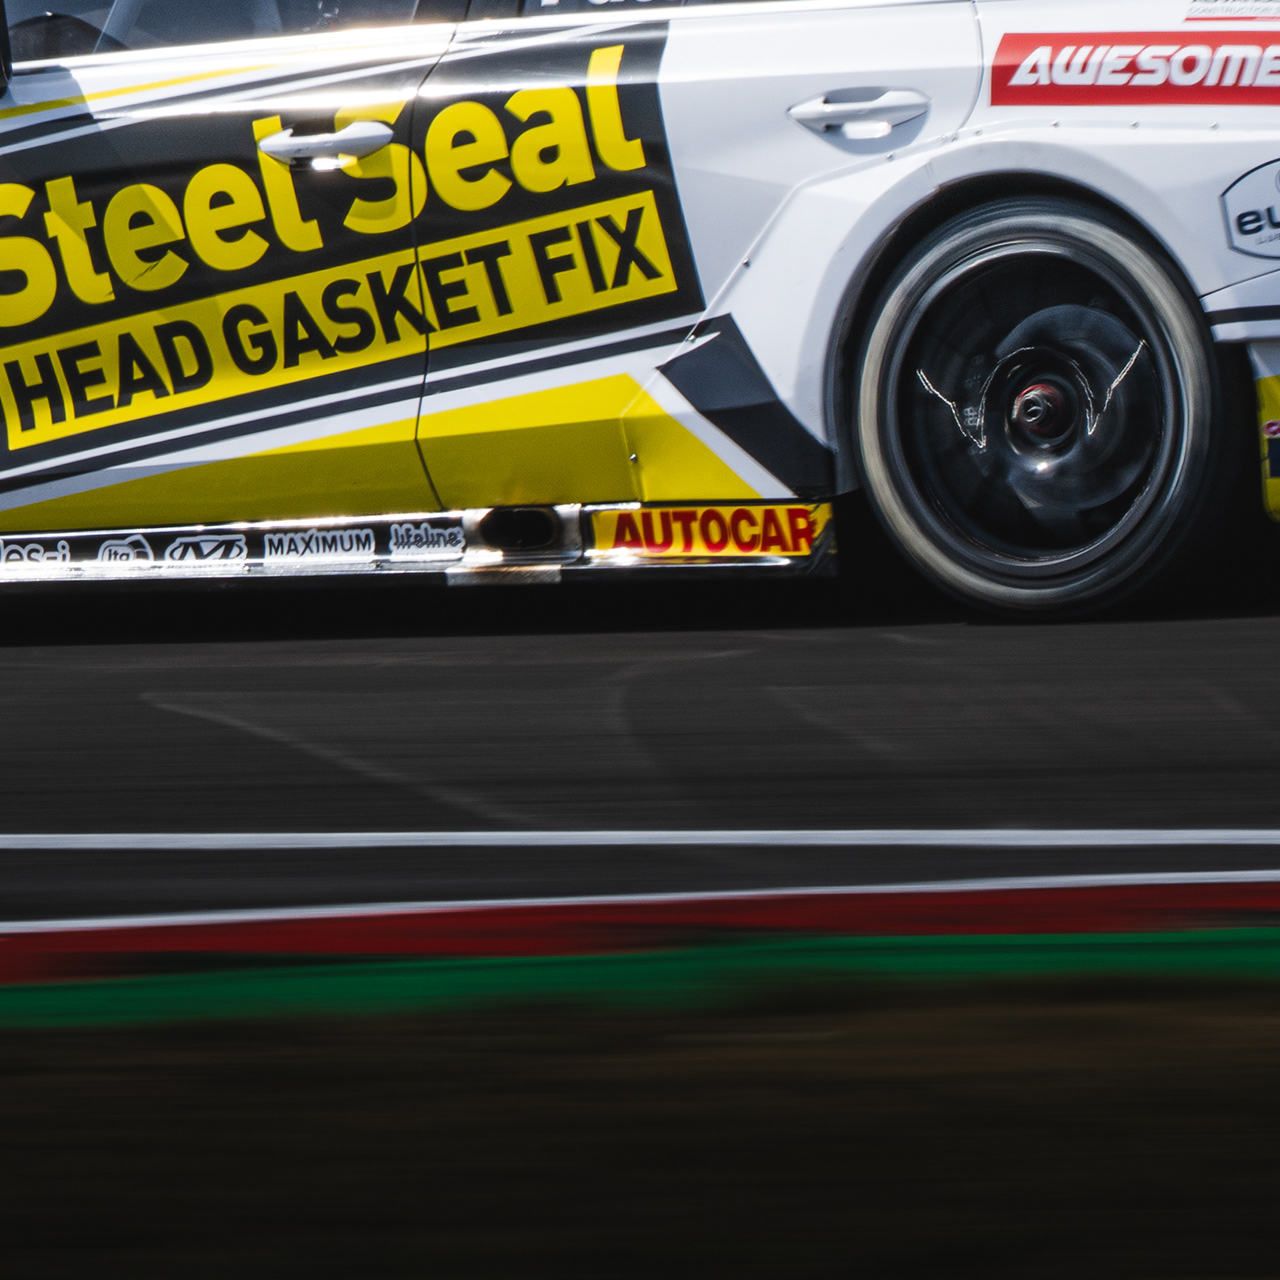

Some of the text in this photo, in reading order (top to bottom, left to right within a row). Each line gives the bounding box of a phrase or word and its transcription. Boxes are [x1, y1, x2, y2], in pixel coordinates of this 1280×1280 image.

[335, 45, 647, 235] Seal
[3, 206, 663, 431] HEAD GASKET FIX
[267, 529, 374, 556] MAXIMUM
[393, 524, 462, 552] lifeline
[613, 508, 816, 554] AUTOCAR
